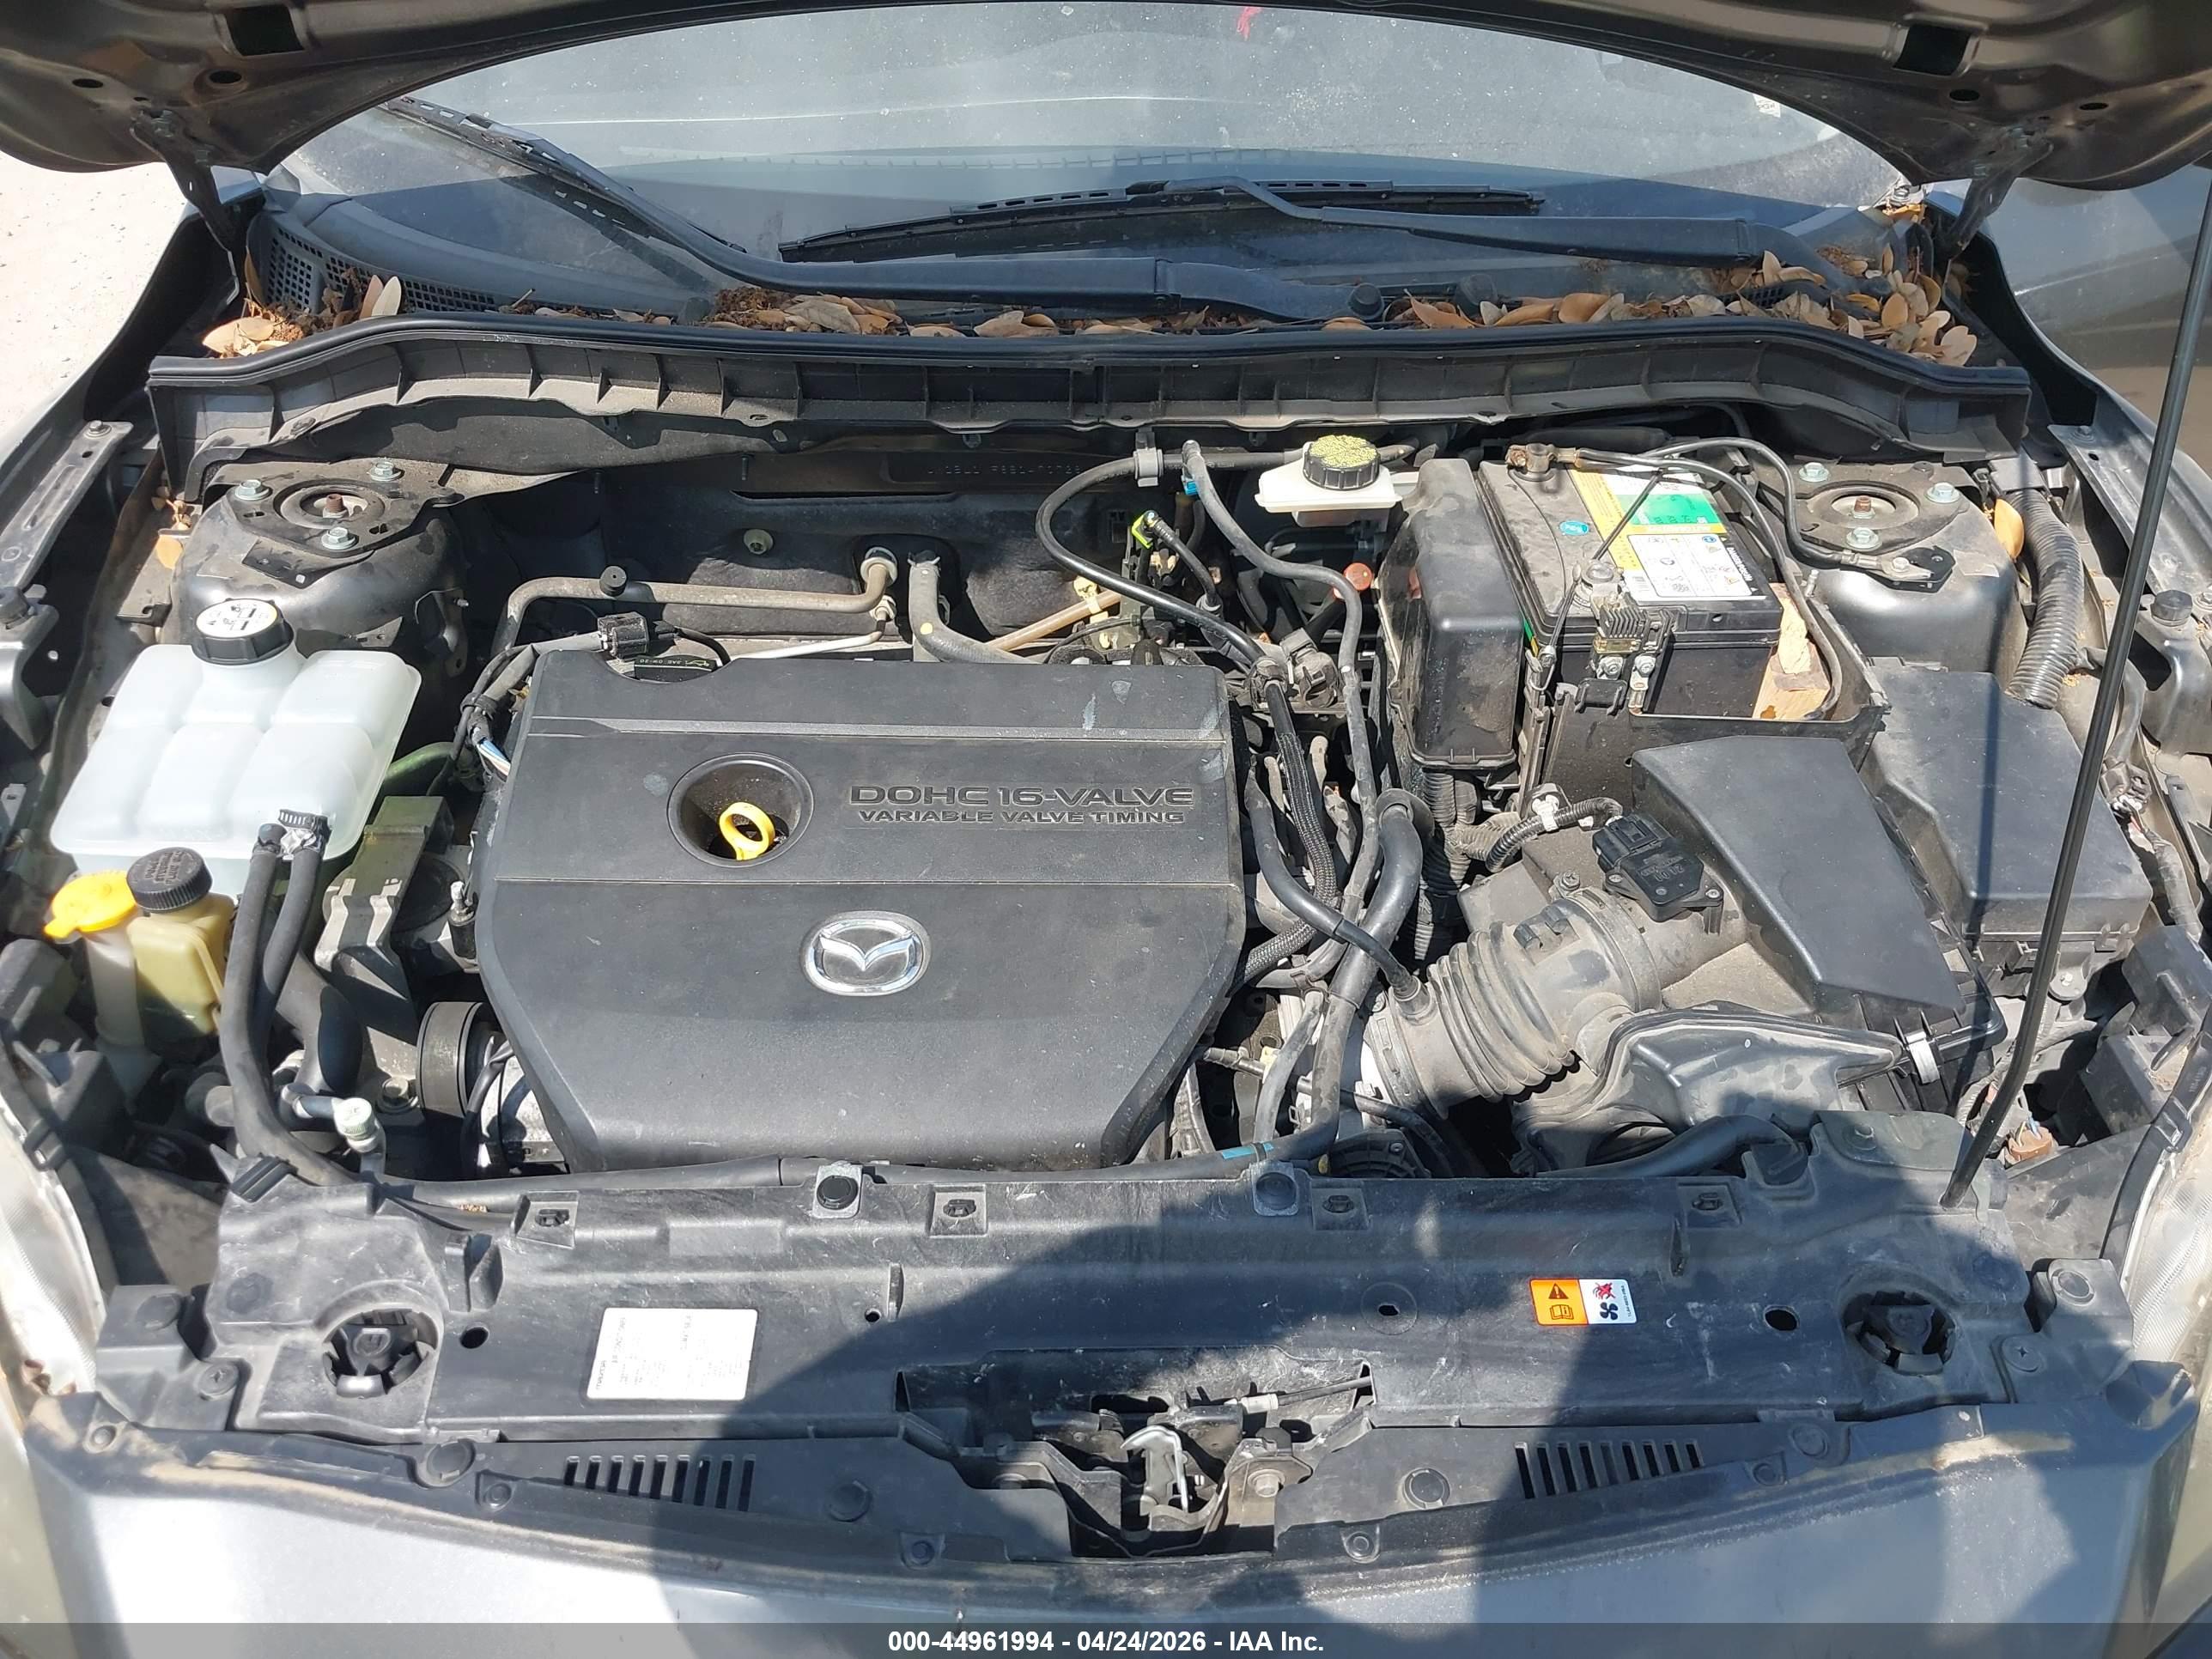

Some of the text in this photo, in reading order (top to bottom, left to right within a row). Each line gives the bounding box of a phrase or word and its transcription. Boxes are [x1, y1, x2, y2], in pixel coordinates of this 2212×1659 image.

[850, 786, 1194, 806] DOHC 16-VALVE
[859, 810, 1185, 823] VARIABLE VALVE TIMING
